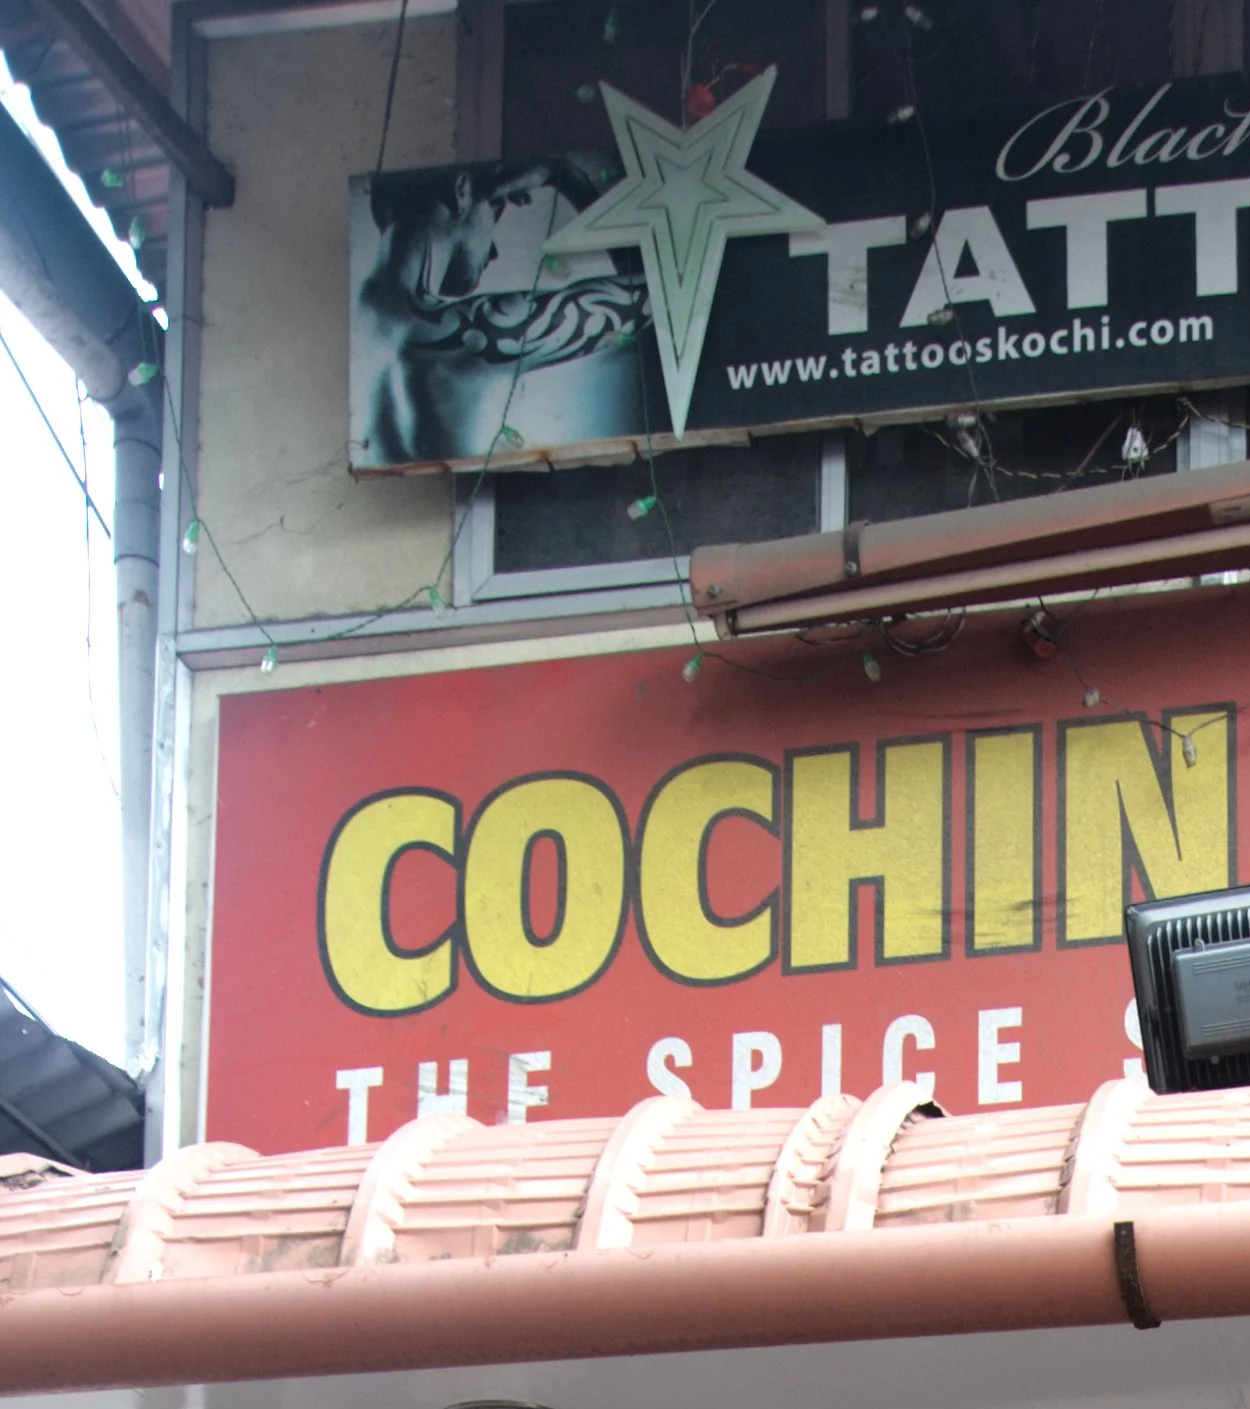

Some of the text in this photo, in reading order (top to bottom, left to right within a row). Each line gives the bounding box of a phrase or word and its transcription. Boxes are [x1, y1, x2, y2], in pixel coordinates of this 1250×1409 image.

[726, 312, 1214, 391] www.tattooskochi.com
[317, 702, 1238, 1018] COCHIN
[646, 1007, 1023, 1110] SPICE
